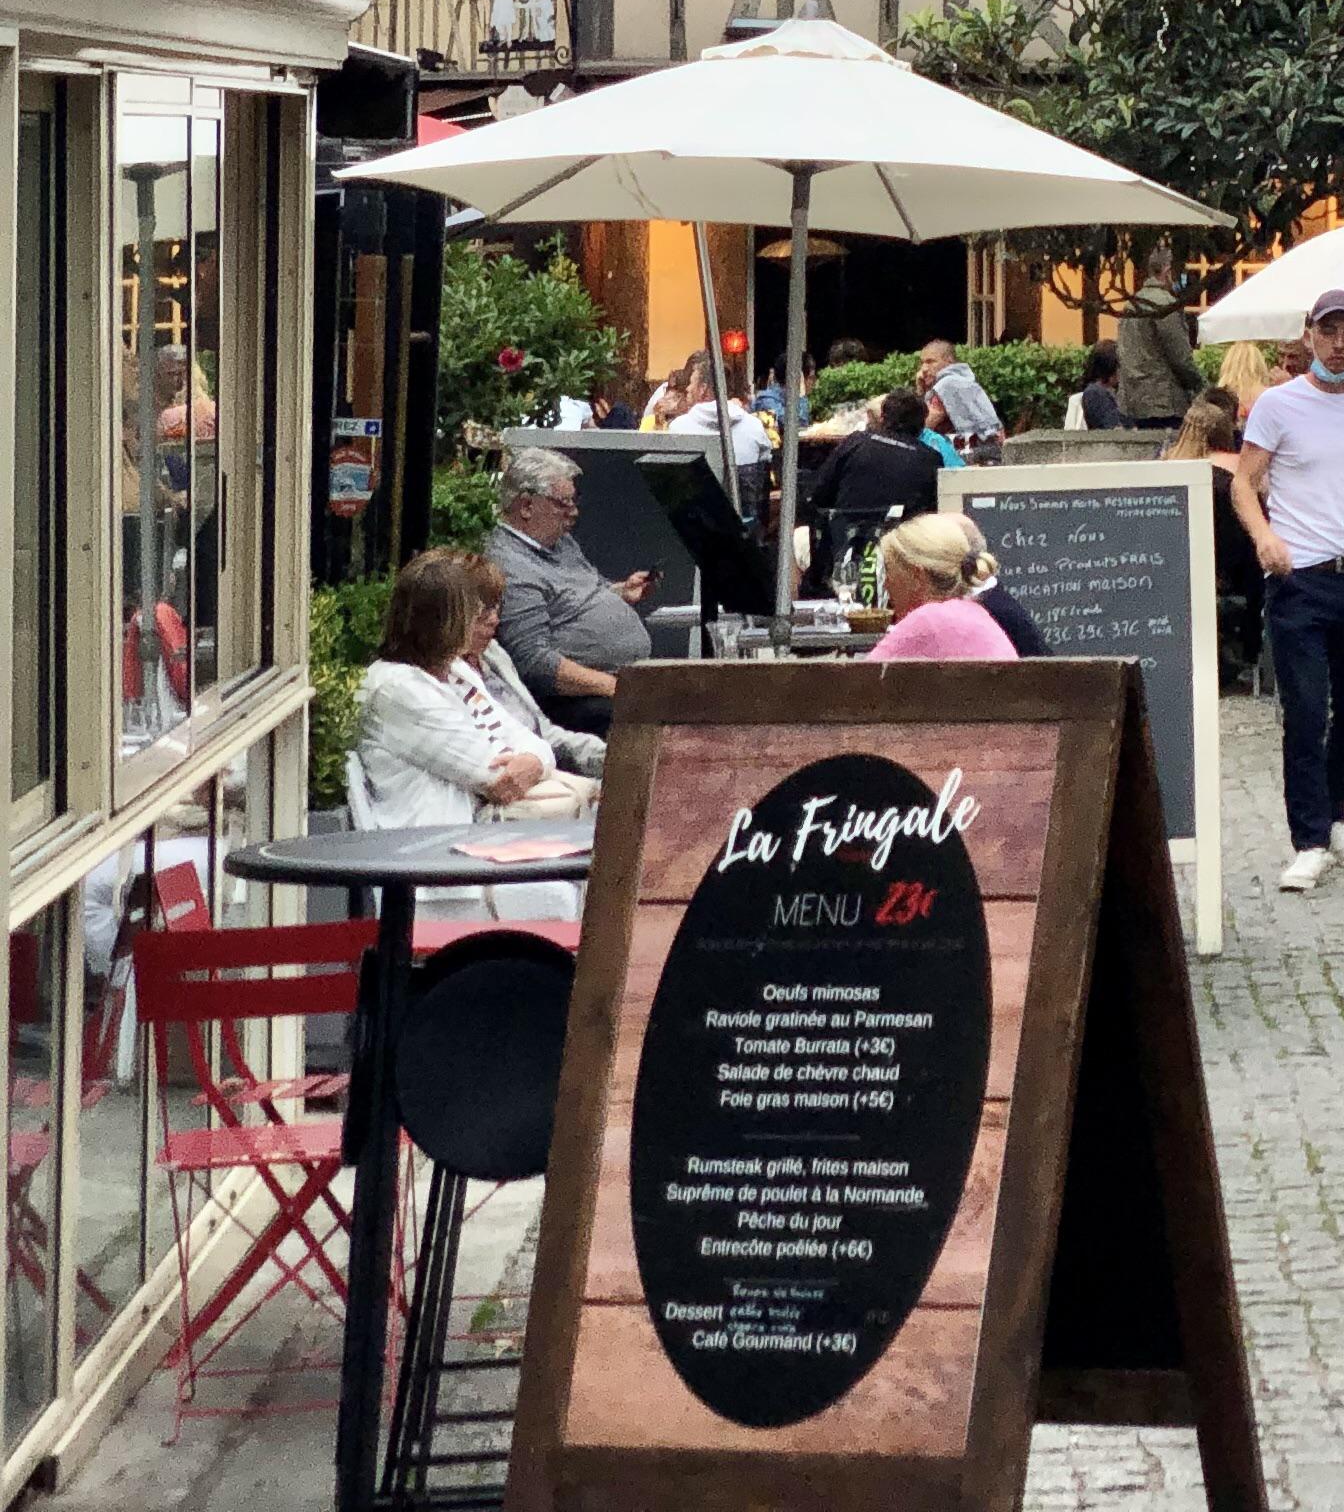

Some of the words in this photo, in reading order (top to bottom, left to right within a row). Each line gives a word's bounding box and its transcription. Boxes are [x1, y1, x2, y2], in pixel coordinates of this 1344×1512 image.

[718, 807, 782, 874] La
[791, 767, 983, 872] Fringale
[772, 892, 863, 928] MENU
[763, 983, 809, 1002] Oeufs
[811, 984, 881, 1002] mimosas
[705, 1008, 762, 1028] Raviole
[764, 1009, 827, 1032] gratinée
[830, 1014, 851, 1029] au
[853, 1009, 934, 1029] Parmesan
[735, 1037, 791, 1055] Tomate
[793, 1037, 851, 1055] Burrata
[853, 1037, 897, 1059] (+3€)
[716, 1063, 771, 1082] Salade
[772, 1063, 794, 1081] de
[797, 1063, 849, 1082] chèvre
[851, 1063, 901, 1082] chaud
[719, 1090, 753, 1108] Foie
[755, 1094, 790, 1112] gras
[793, 1090, 850, 1109] maison
[852, 1090, 895, 1112] (+5€)
[686, 1156, 763, 1177] Rumsteak
[810, 1156, 849, 1177] frites
[852, 1158, 910, 1177] maison
[665, 1182, 735, 1206] Suprême
[737, 1184, 758, 1203] de
[760, 1184, 808, 1206] poulet
[825, 1185, 840, 1204] la
[843, 1185, 925, 1205] Normande
[737, 1211, 786, 1230] Pêche
[789, 1211, 809, 1230] du
[811, 1212, 844, 1235] jour
[700, 1236, 773, 1257] Entrecôte
[775, 1239, 828, 1261] poêlée
[831, 1239, 874, 1263] (+6€)
[664, 1301, 724, 1321] Dessert
[691, 1329, 730, 1352] Café
[731, 1330, 813, 1352] Gourmand
[815, 1332, 858, 1355] (+3€)
